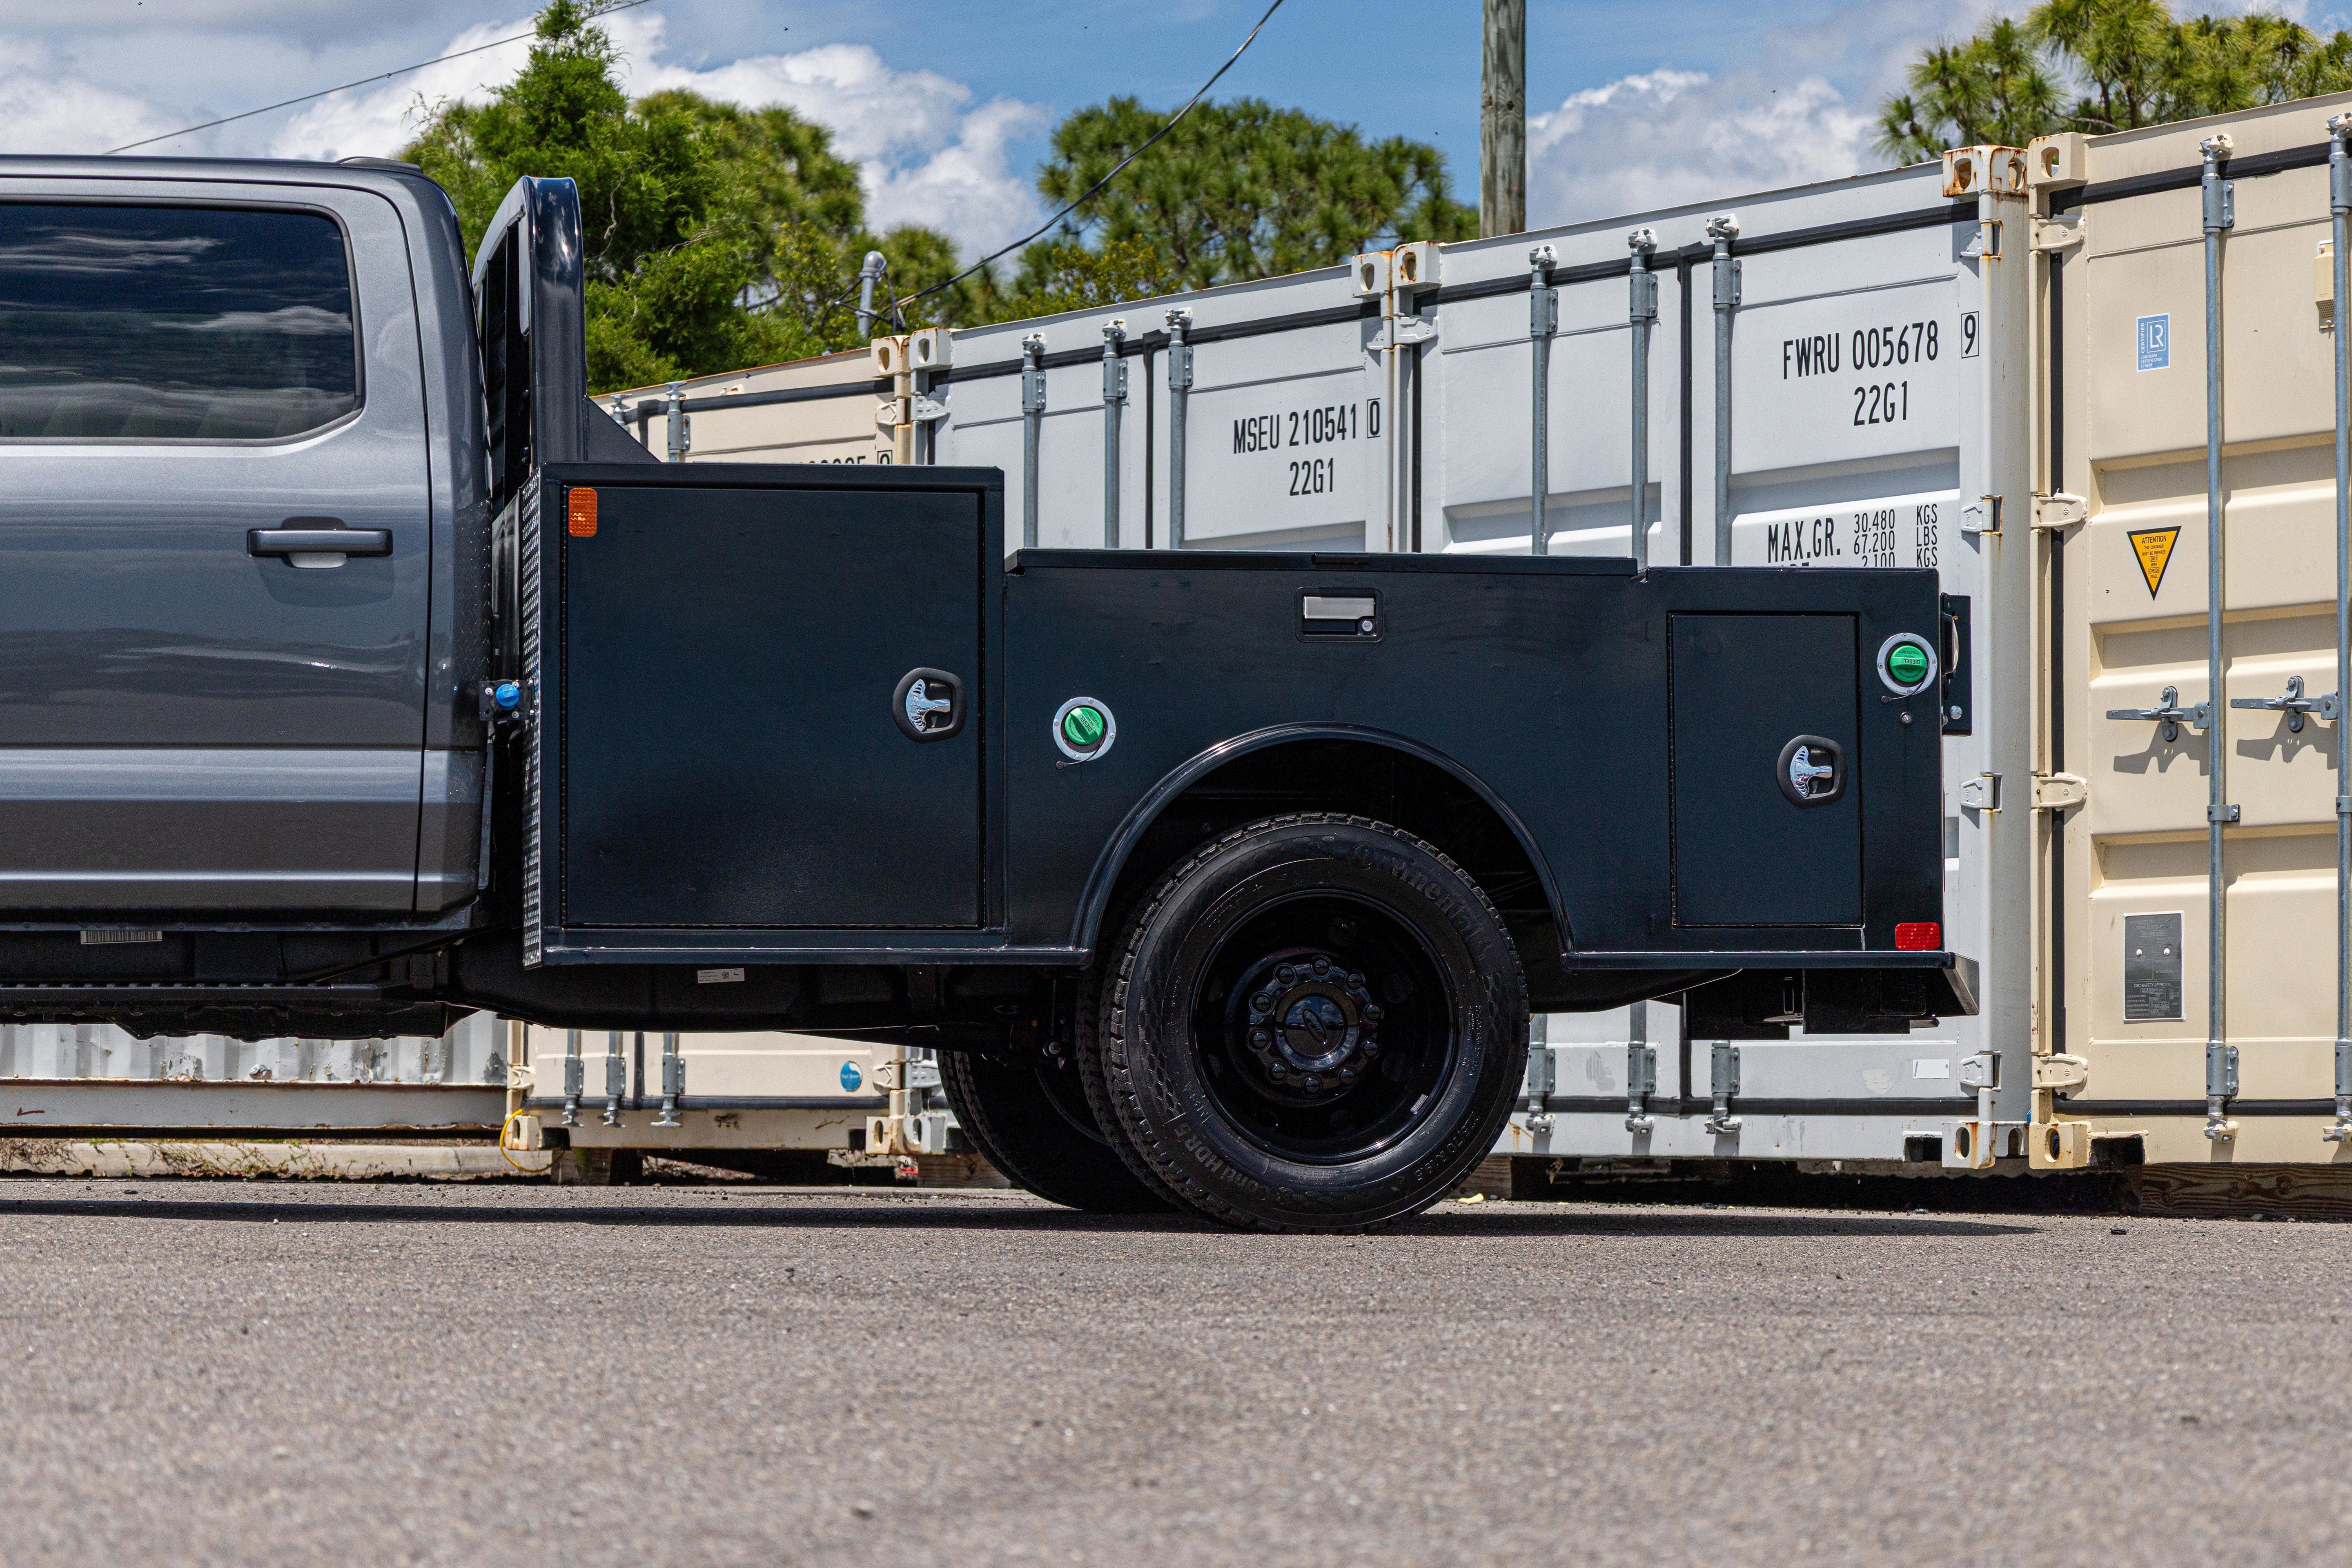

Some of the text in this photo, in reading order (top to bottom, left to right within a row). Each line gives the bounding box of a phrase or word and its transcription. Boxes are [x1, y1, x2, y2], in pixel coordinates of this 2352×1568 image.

[1783, 314, 1976, 379] FWRU 005678 9
[1853, 381, 1907, 426] 22G1
[1234, 400, 1380, 454] MSEU 210541 0
[1290, 458, 1334, 496] 22G1
[1768, 517, 1841, 563] MAX.GR.
[1854, 509, 1895, 533] 30,480
[1916, 503, 1938, 526] KGS
[1854, 525, 1938, 555] 67,200 LBS
[2142, 535, 2166, 544] ATTENTION
[1862, 546, 1938, 567] 2100 KGS
[1080, 715, 1093, 732] DIESEL
